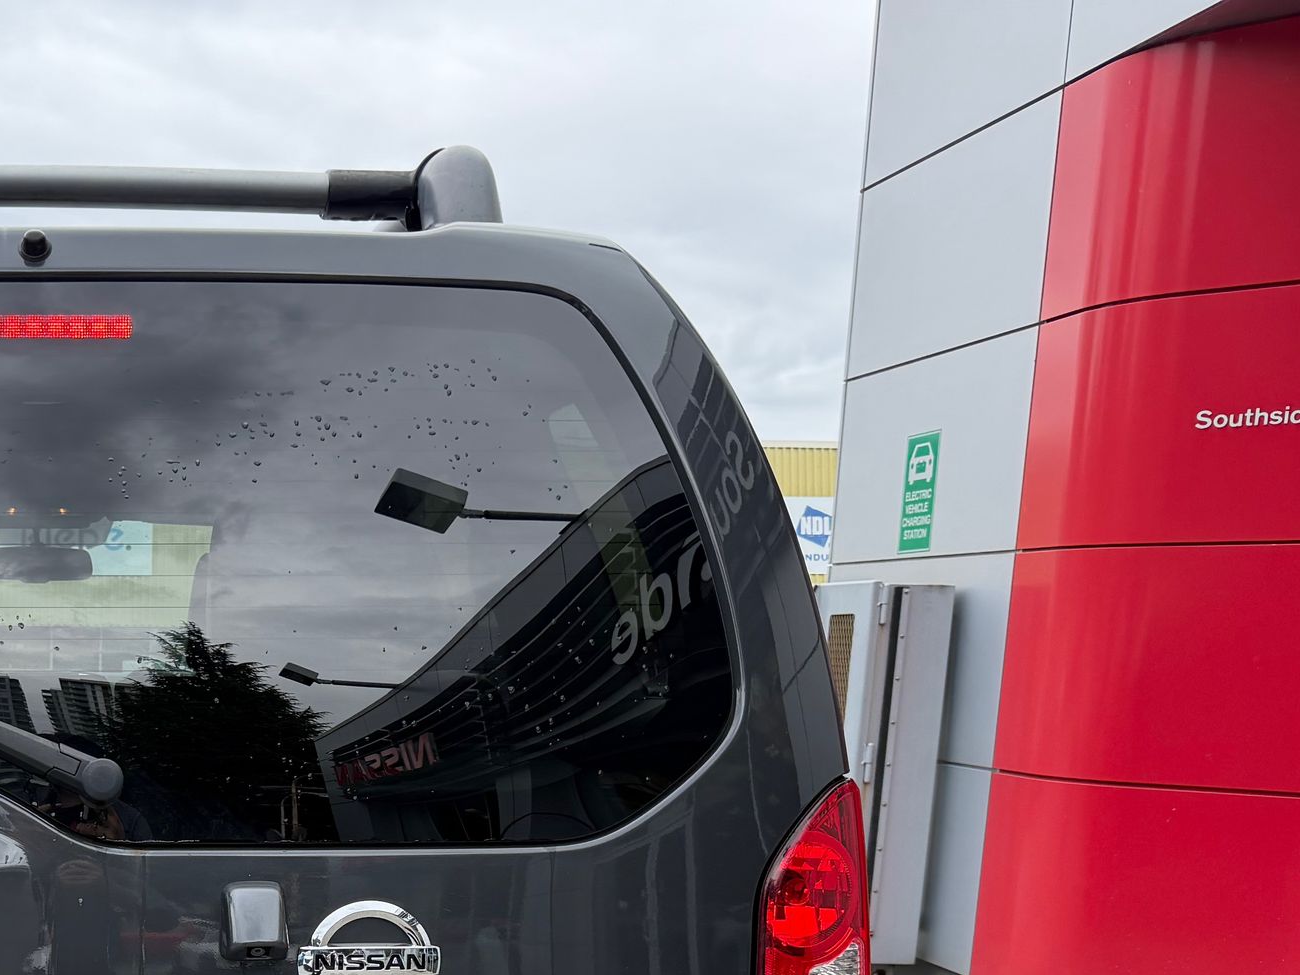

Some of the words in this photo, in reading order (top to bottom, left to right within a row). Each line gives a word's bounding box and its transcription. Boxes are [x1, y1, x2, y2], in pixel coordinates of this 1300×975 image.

[905, 488, 932, 502] ELECTRIC
[905, 502, 929, 514] VEHICLE
[800, 516, 832, 535] NDL
[902, 514, 931, 528] CHARGING
[903, 528, 927, 540] STATION
[314, 953, 427, 971] NISSAN
